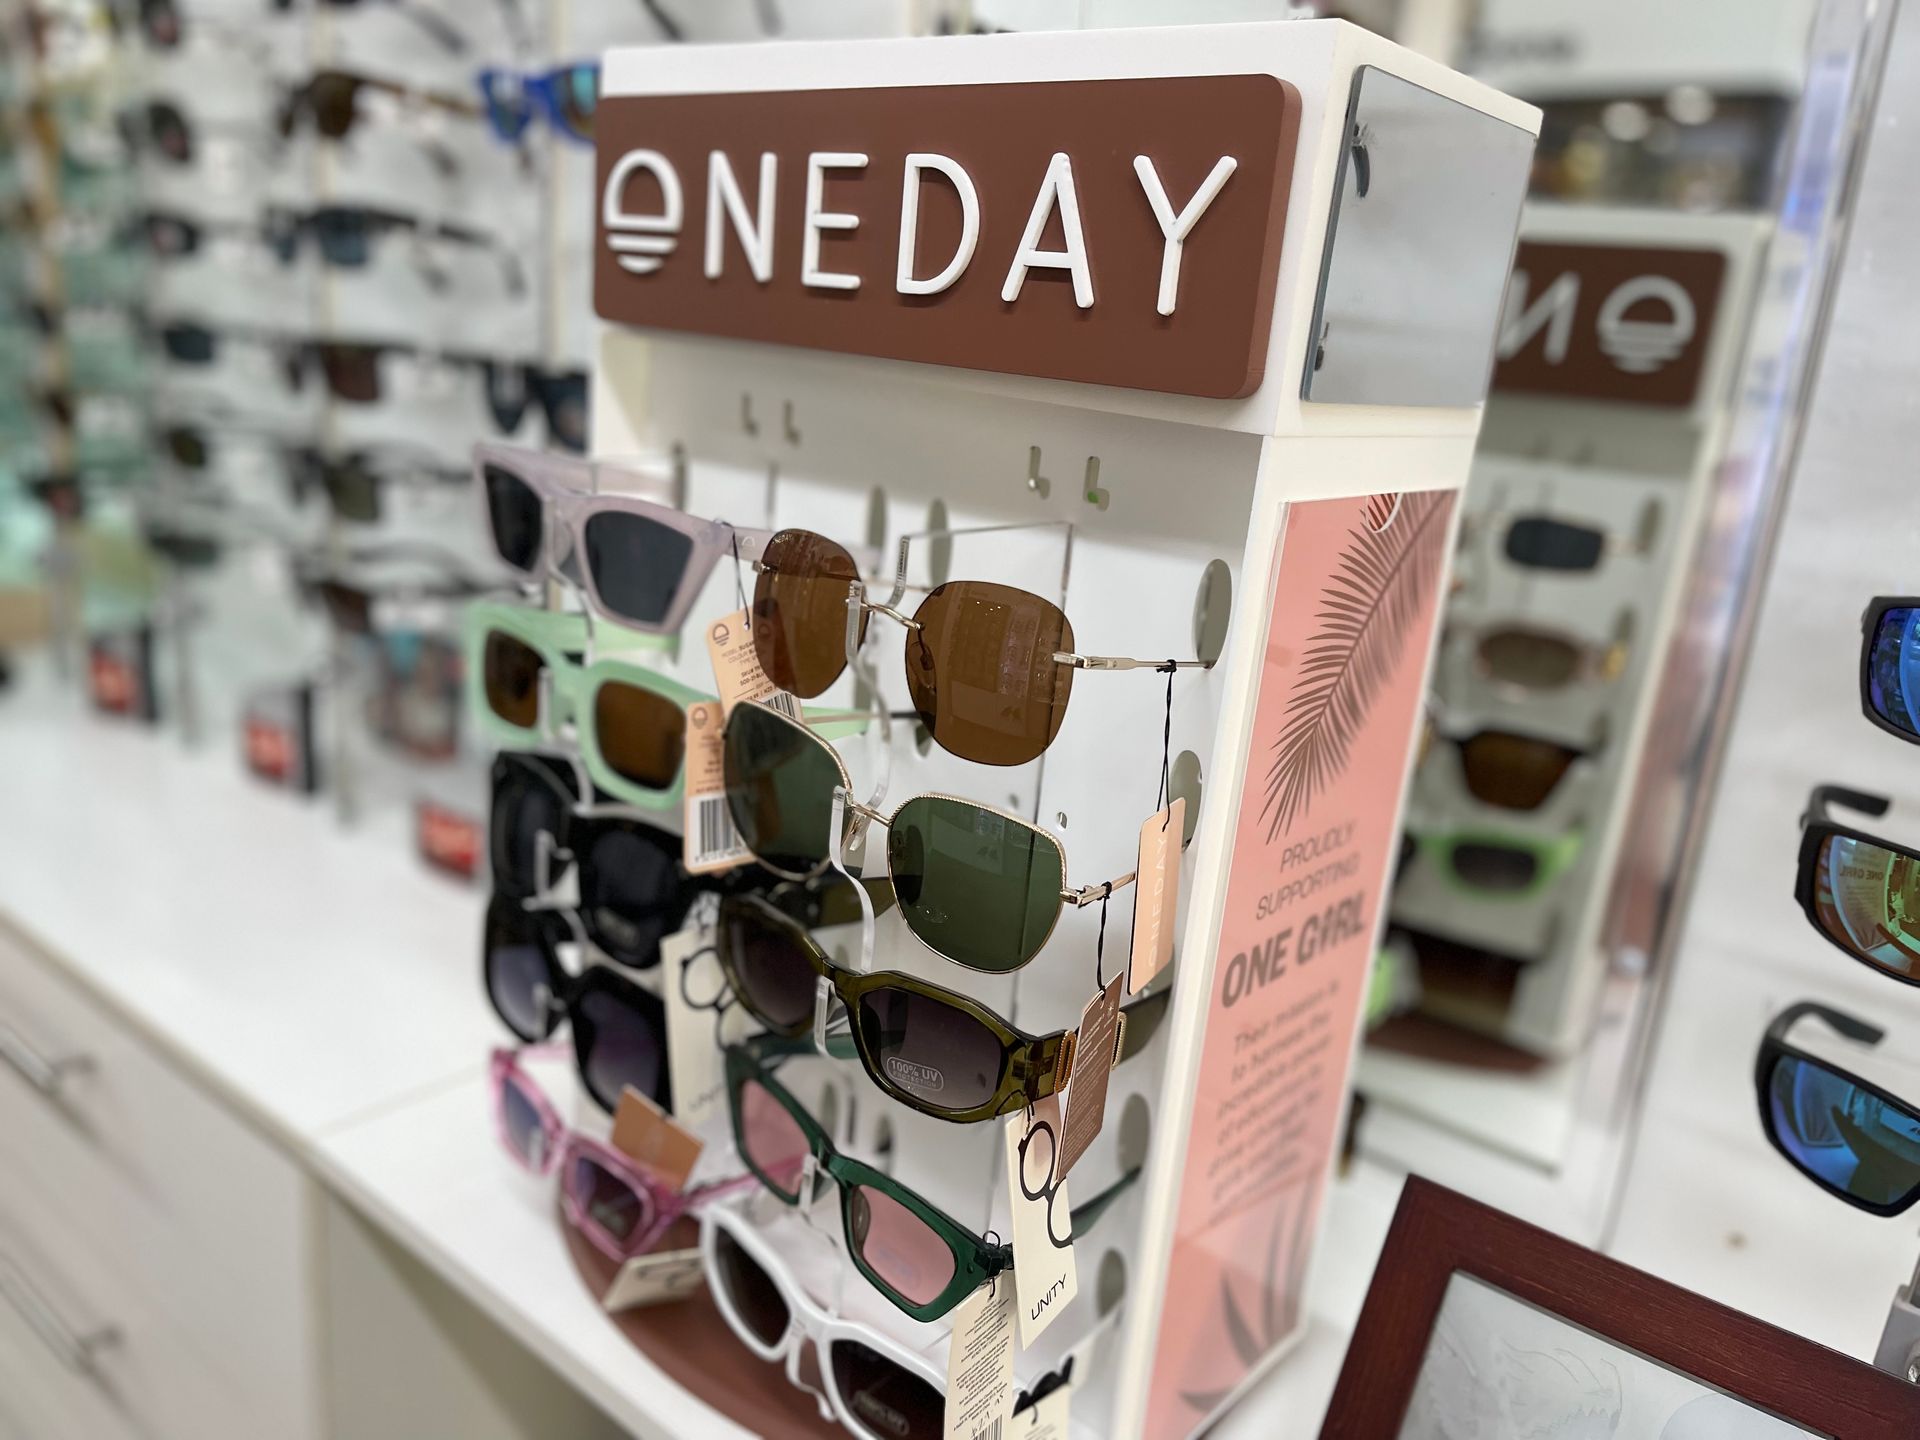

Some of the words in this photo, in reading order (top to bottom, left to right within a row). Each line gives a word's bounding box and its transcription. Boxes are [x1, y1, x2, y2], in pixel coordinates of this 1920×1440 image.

[603, 148, 1238, 317] ONEDAY
[1280, 819, 1357, 874] PROUDLY
[1255, 851, 1361, 920] SUPPORTING
[1222, 926, 1293, 1008] ONE
[1295, 888, 1366, 967] GIRL
[891, 1060, 919, 1077] 100%
[922, 1068, 938, 1082] UV
[891, 1070, 938, 1088] PROTECTION
[1031, 1272, 1067, 1321] UNITY
